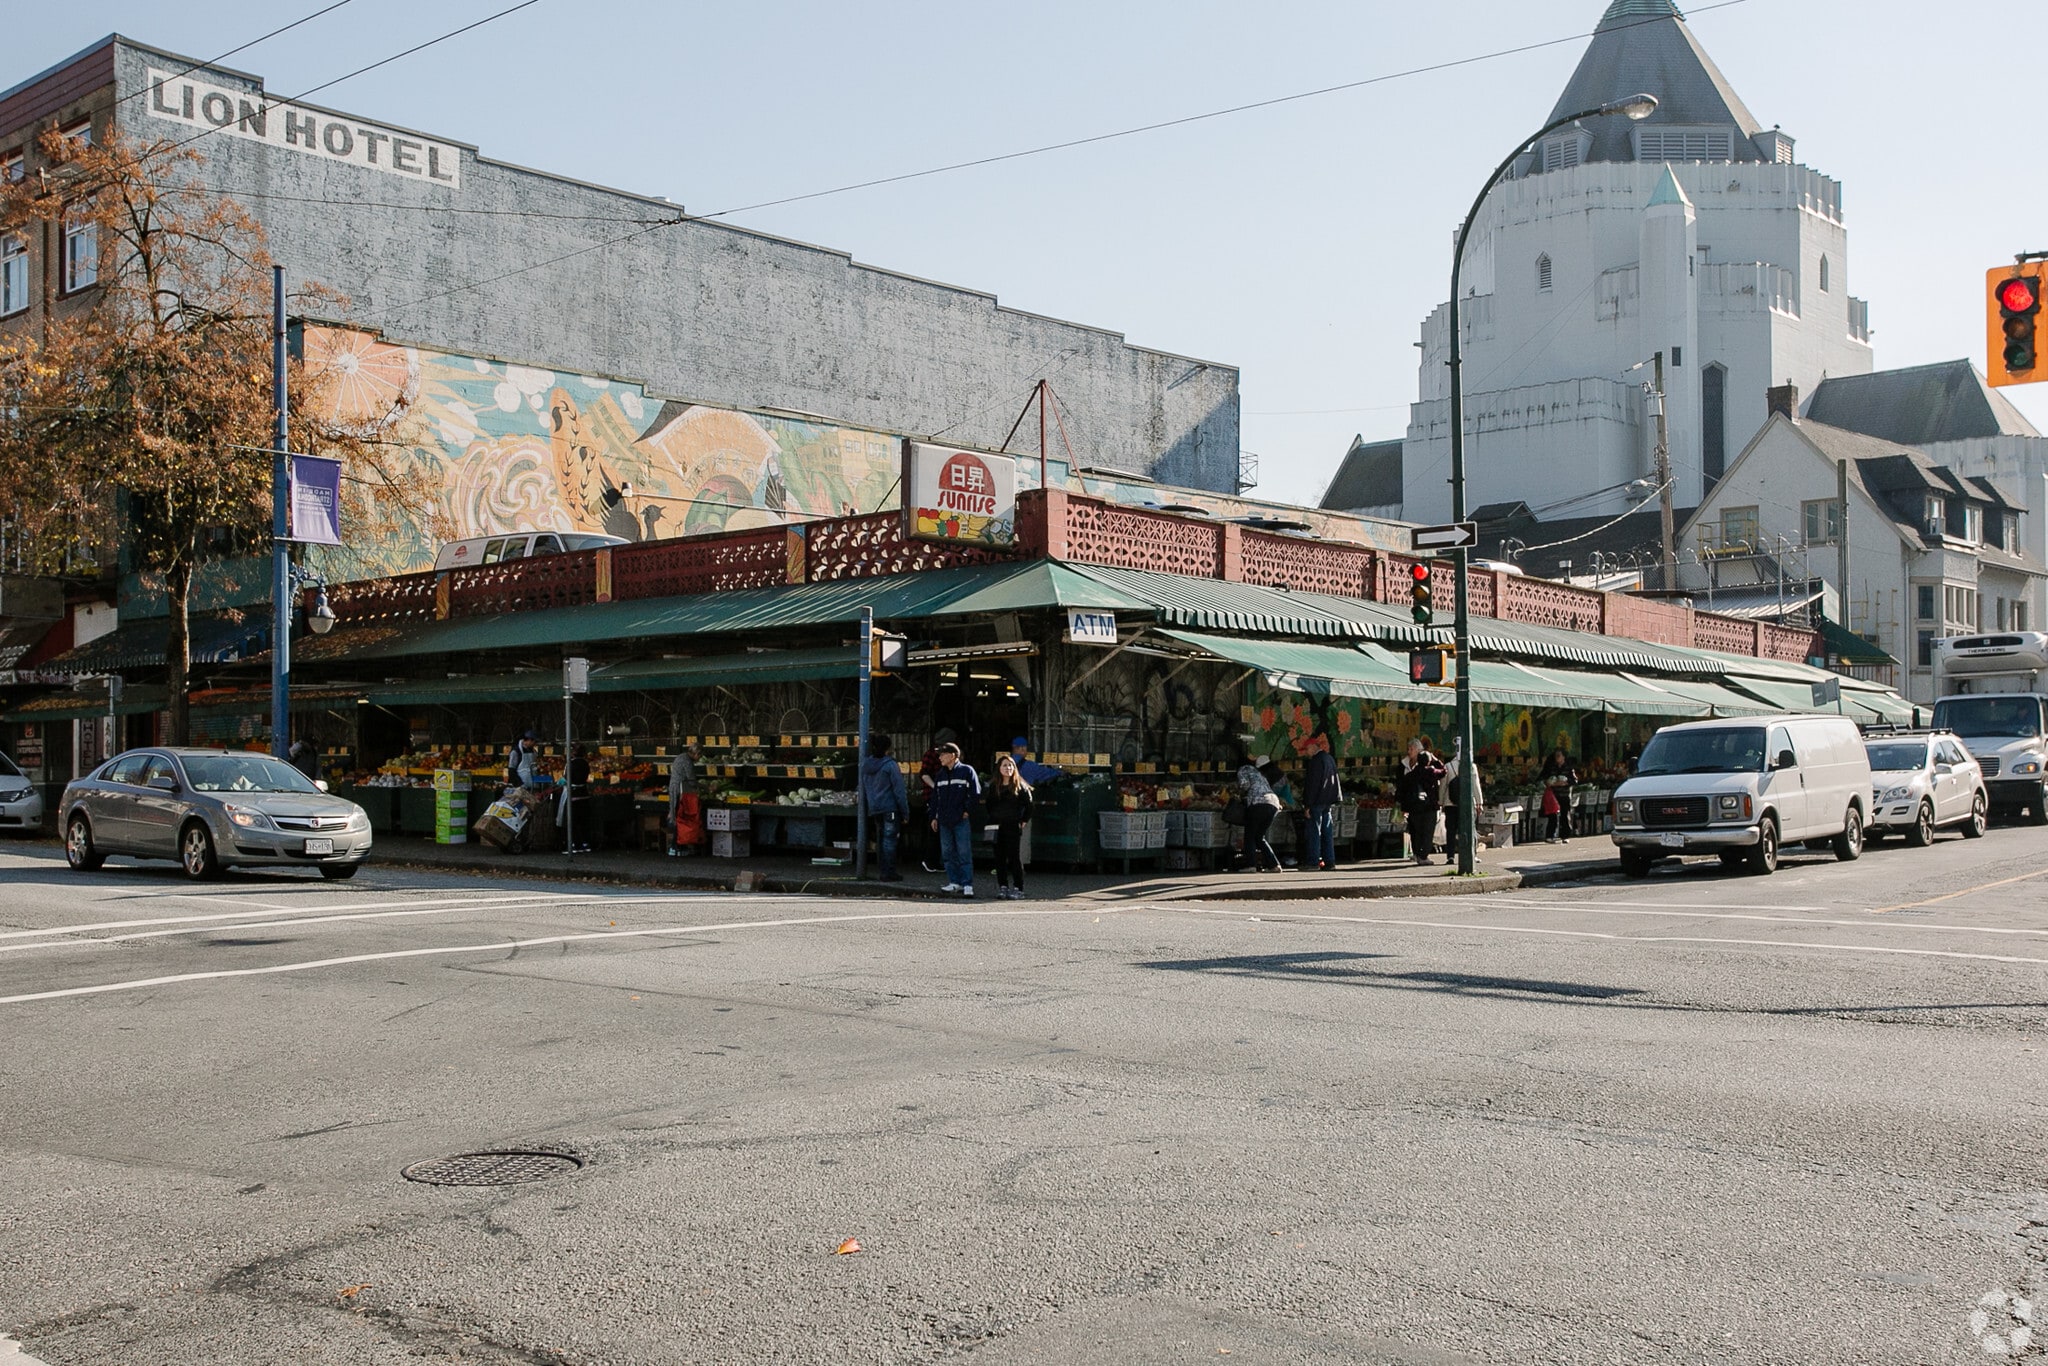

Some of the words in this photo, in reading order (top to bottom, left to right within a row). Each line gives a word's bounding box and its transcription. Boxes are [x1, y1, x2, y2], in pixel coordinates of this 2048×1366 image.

[153, 76, 266, 138] LION
[285, 110, 453, 182] HOTEL
[950, 463, 986, 493] 日昇
[1073, 613, 1115, 637] ATM
